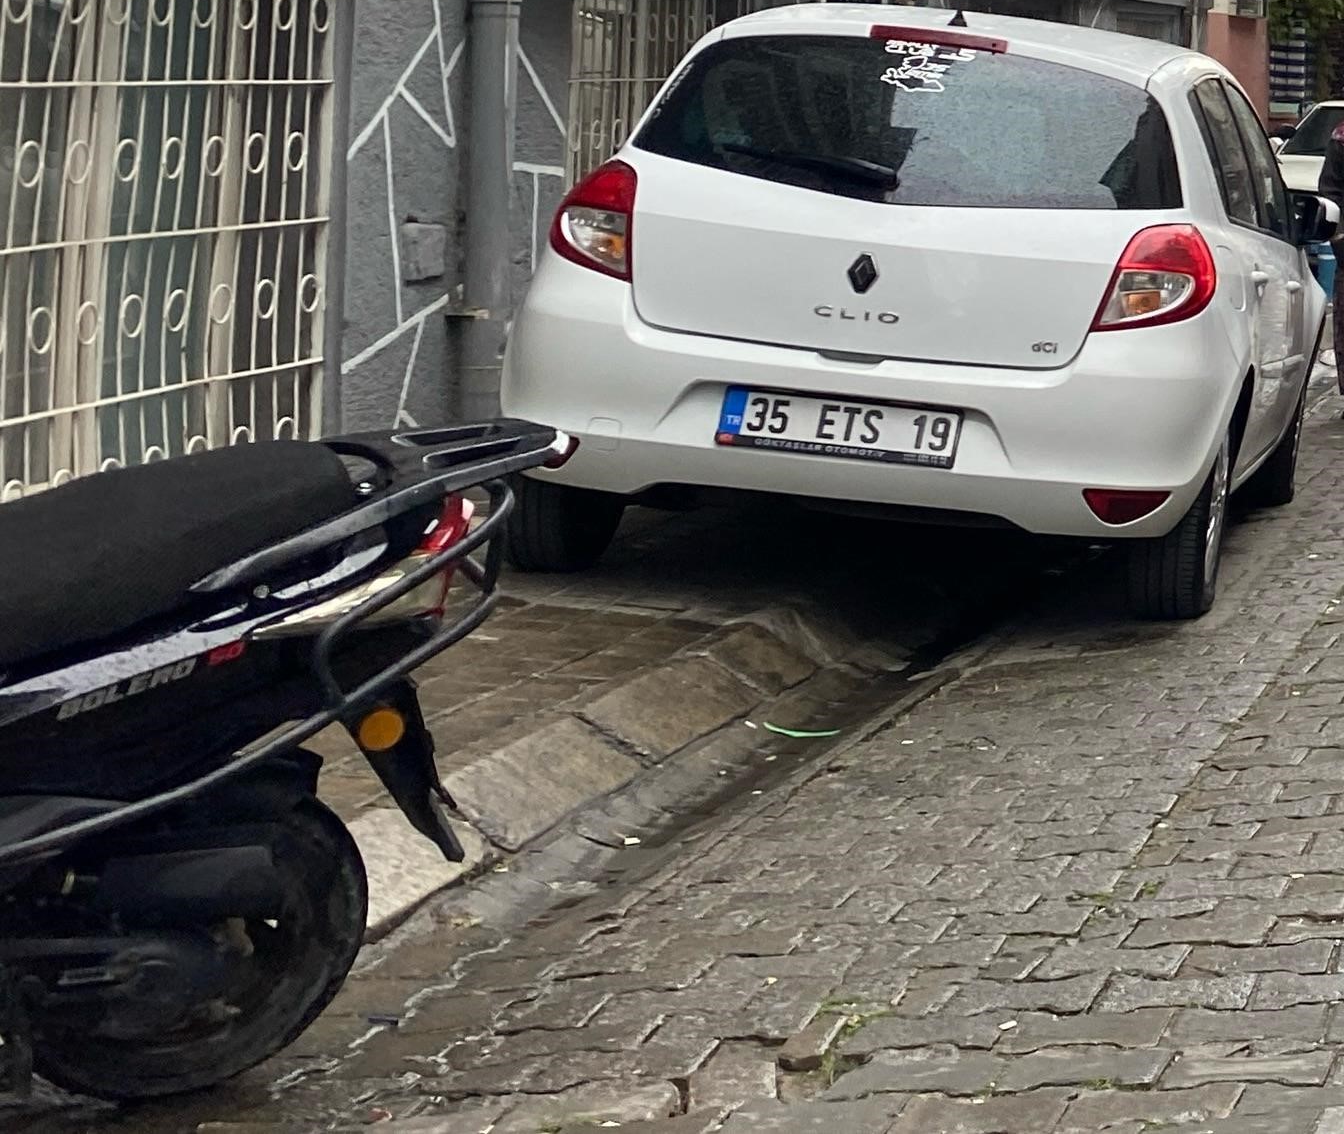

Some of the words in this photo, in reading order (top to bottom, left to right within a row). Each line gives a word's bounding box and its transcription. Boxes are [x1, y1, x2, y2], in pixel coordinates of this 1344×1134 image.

[814, 305, 900, 324] CLIO
[1032, 340, 1058, 354] dCi
[726, 415, 741, 426] TR
[746, 397, 790, 434] 35
[816, 404, 883, 444] ETS
[913, 415, 951, 452] 19
